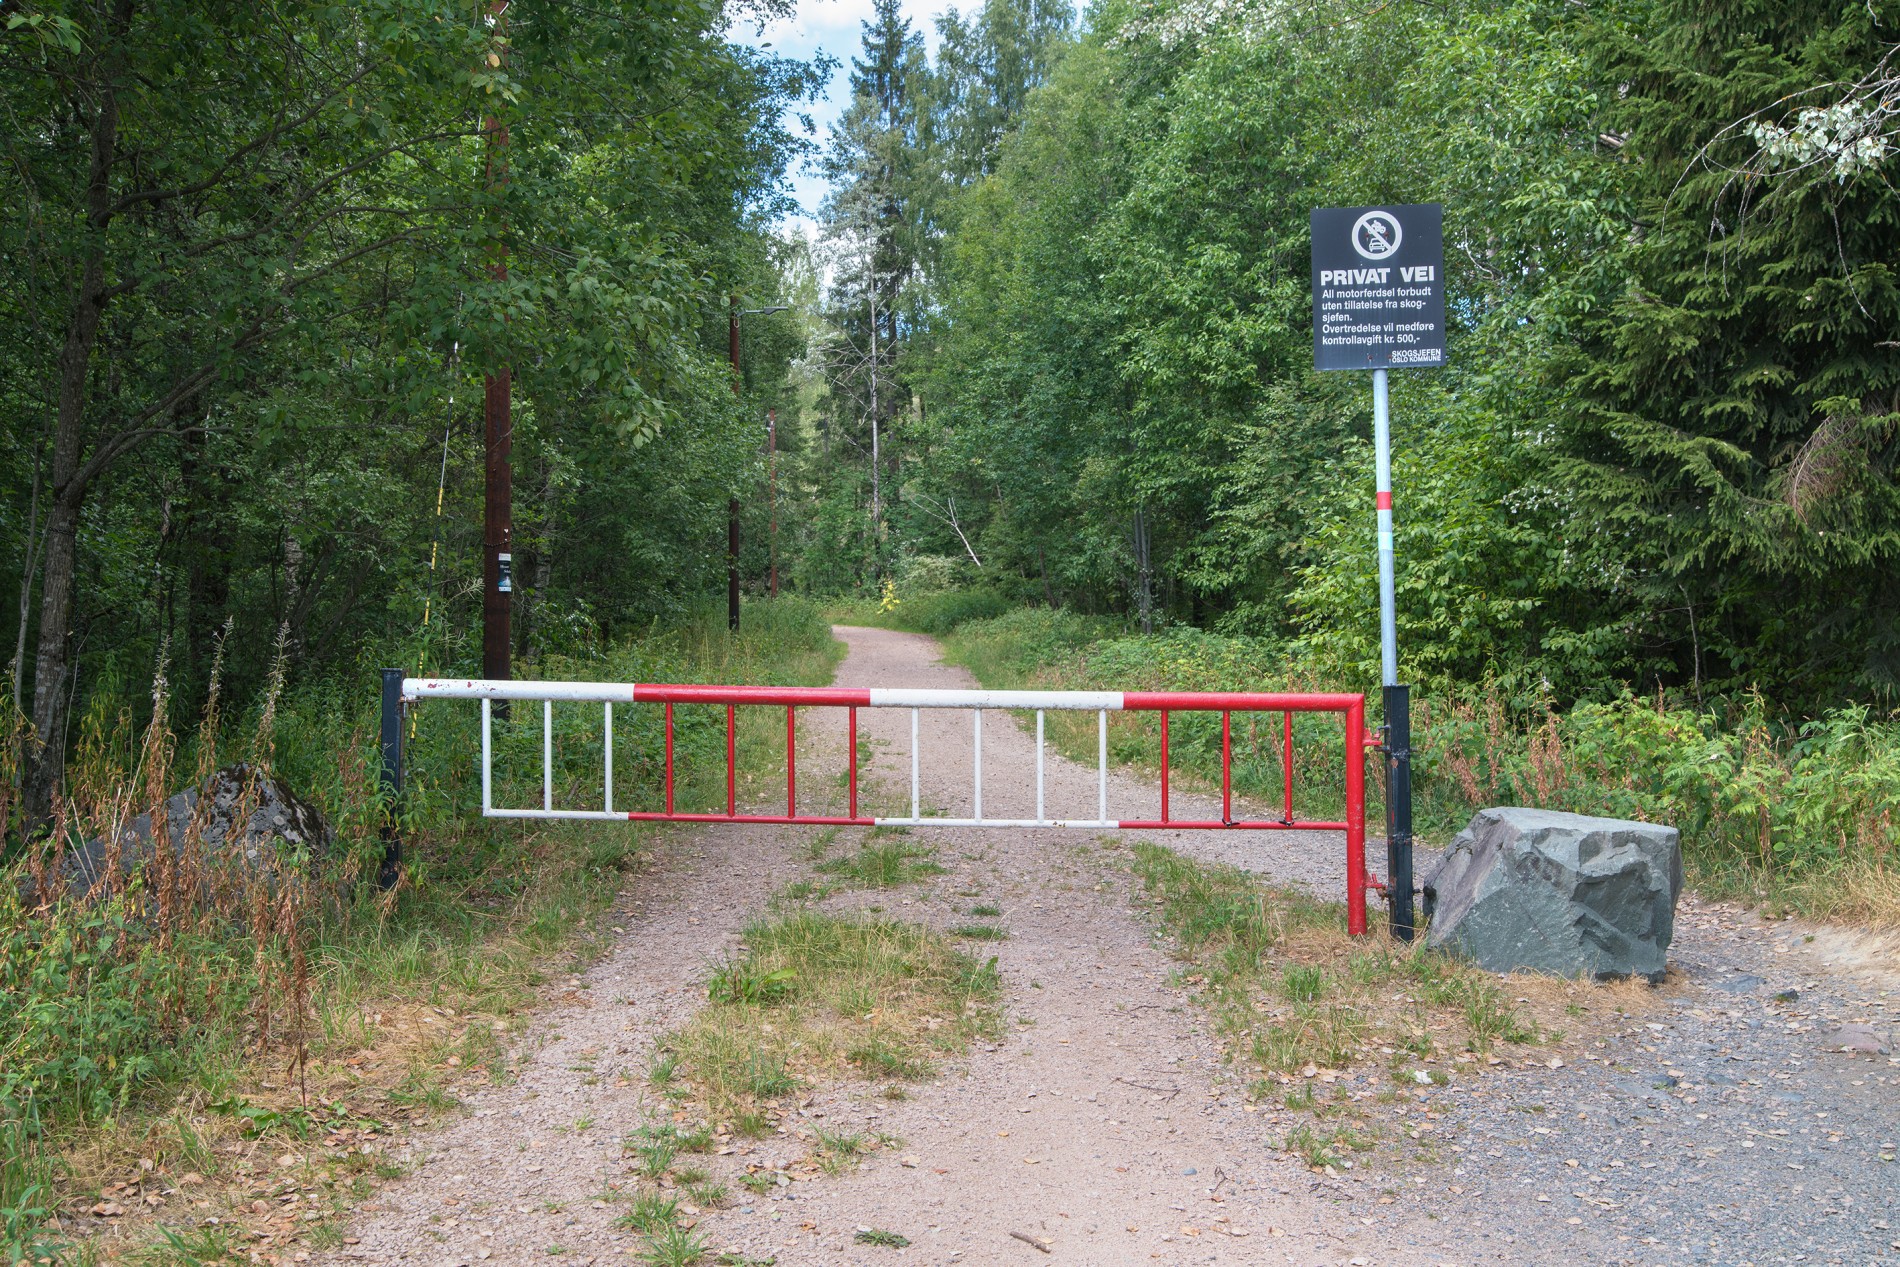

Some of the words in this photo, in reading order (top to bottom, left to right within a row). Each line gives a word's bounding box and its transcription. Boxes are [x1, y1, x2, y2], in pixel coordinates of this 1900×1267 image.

[1321, 268, 1390, 286] PRIVAT
[1400, 266, 1434, 282] VEI
[1322, 289, 1334, 298] All
[1337, 288, 1394, 298] motorferdsel
[1397, 287, 1431, 296] forbudt
[1322, 302, 1342, 310] uten
[1344, 300, 1383, 309] tillatelse
[1385, 300, 1397, 308] fra
[1400, 299, 1426, 310] skog-
[1322, 313, 1352, 322] sjefen.
[1322, 324, 1381, 333] Overtredelse
[1383, 323, 1393, 331] vil
[1396, 322, 1434, 331] medføre
[1322, 335, 1382, 345] kontrollavgift
[1384, 335, 1394, 343] kr.
[1397, 334, 1420, 344] 500,-
[1392, 348, 1441, 356] SKOGSJEFEN
